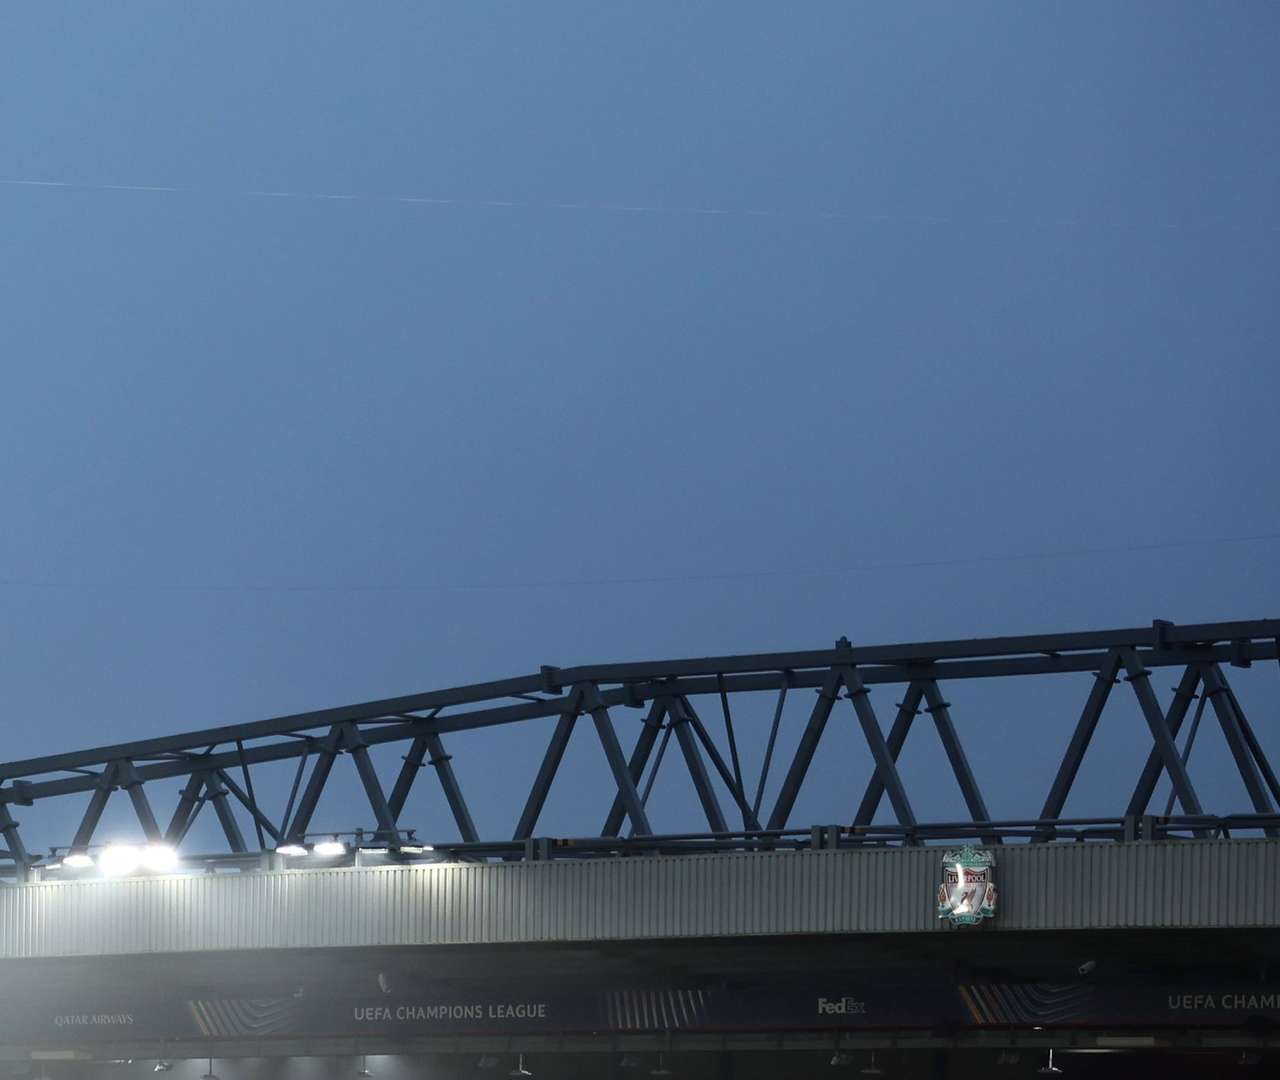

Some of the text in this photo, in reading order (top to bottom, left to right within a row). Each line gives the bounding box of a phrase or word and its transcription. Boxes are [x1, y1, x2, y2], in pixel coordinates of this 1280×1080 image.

[948, 872, 986, 883] LIVPOOL
[817, 997, 867, 1015] FedEx
[1168, 994, 1280, 1009] UEFA CHAM
[354, 1004, 546, 1021] UEFA CHAMPIONS LEAGUE
[54, 1014, 135, 1027] QATAR AIRWAYS
